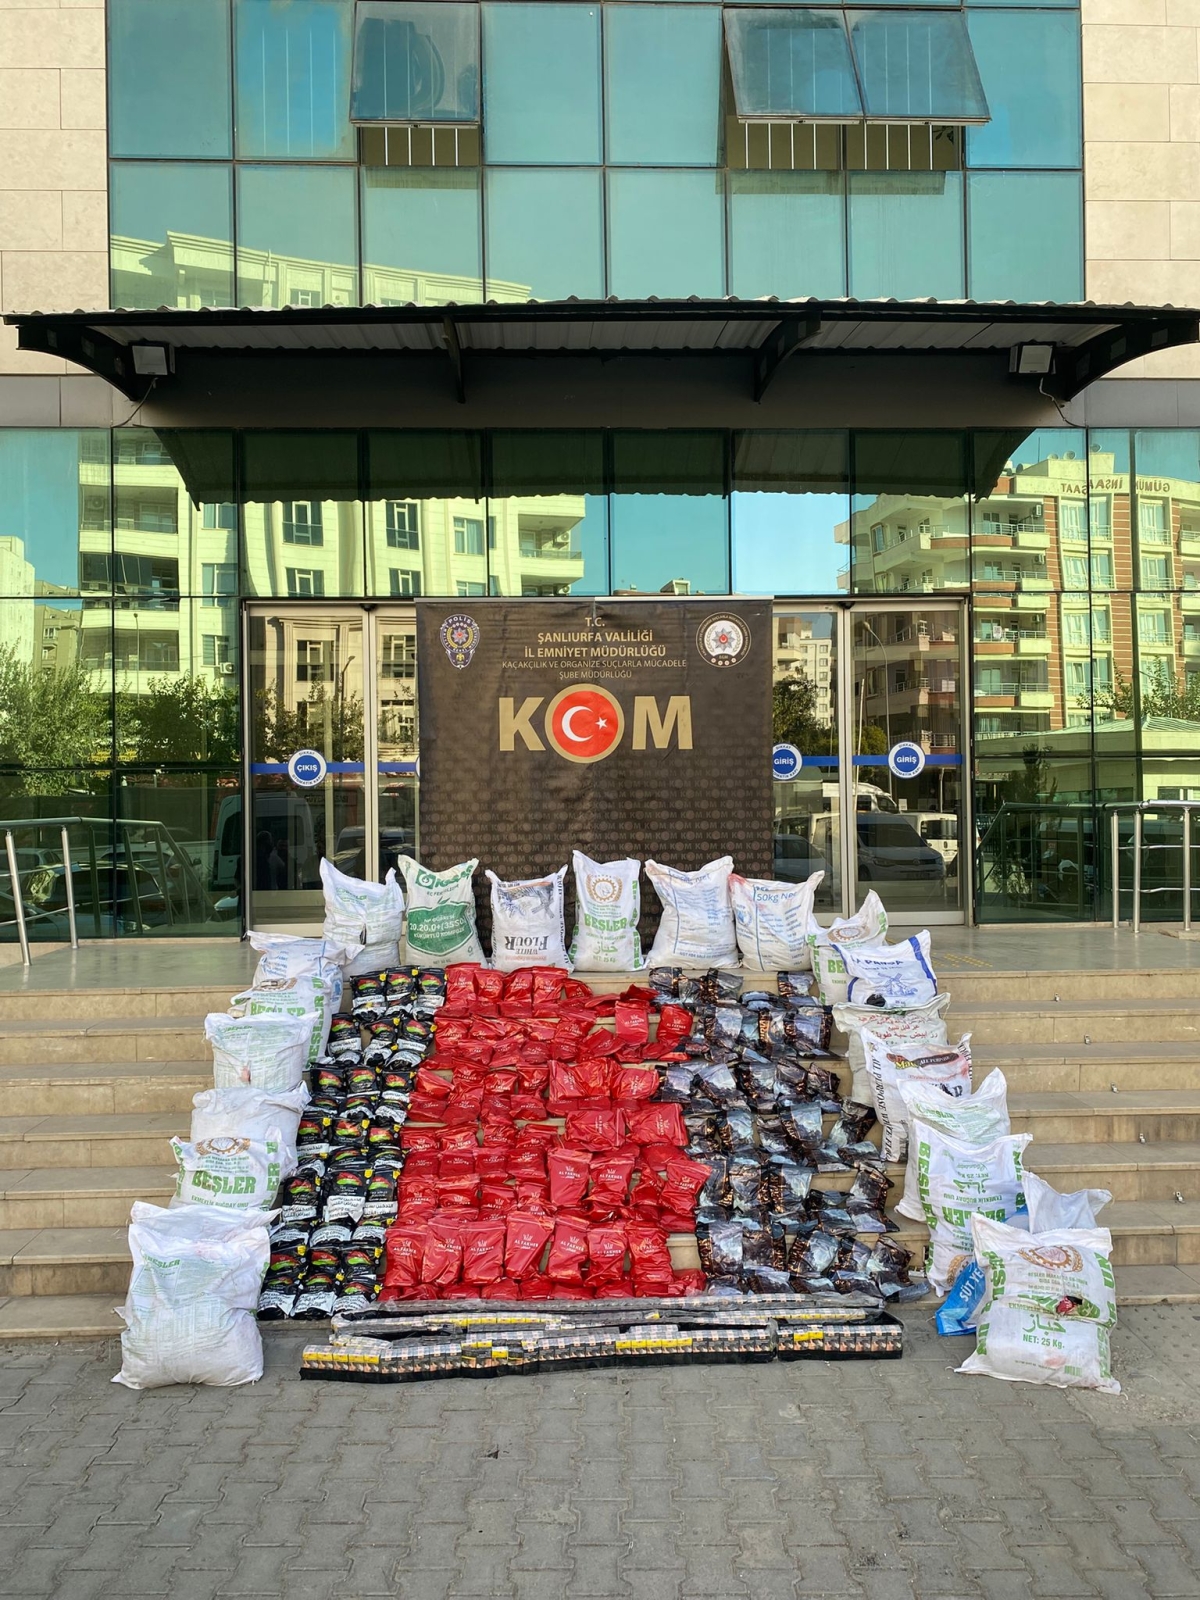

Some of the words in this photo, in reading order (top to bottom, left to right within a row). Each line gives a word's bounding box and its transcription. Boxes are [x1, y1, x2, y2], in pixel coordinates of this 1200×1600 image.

[448, 616, 471, 624] POLİS
[585, 617, 605, 627] T.C.
[537, 632, 602, 645] ŞANLIURFA
[605, 630, 653, 642] VALİLİĞİ
[525, 646, 535, 658] İL
[537, 646, 588, 658] EMNİYET
[590, 645, 666, 657] MÜDÜRLÜĞÜ
[502, 661, 547, 670] KAÇAKÇILIK
[561, 660, 600, 668] ORGANİZE
[602, 660, 642, 669] SUÇLARLA
[644, 659, 686, 668] MÜCADELE
[559, 671, 578, 680] ŞUBE
[581, 670, 632, 679] MÜDÜRLÜĞÜ
[774, 757, 794, 766] GİRİŞ
[896, 756, 917, 765] GİRİŞ
[296, 764, 318, 773] ÇIKIŞ
[504, 936, 549, 951] FLOUR
[873, 1072, 886, 1111] PURPOSE
[191, 1170, 256, 1197] BEŞLER
[959, 1280, 975, 1302] SÜT
[969, 1268, 984, 1283] YE
[1022, 1313, 1067, 1335] خباز
[1023, 1334, 1039, 1344] NET:
[1041, 1337, 1051, 1346] 25
